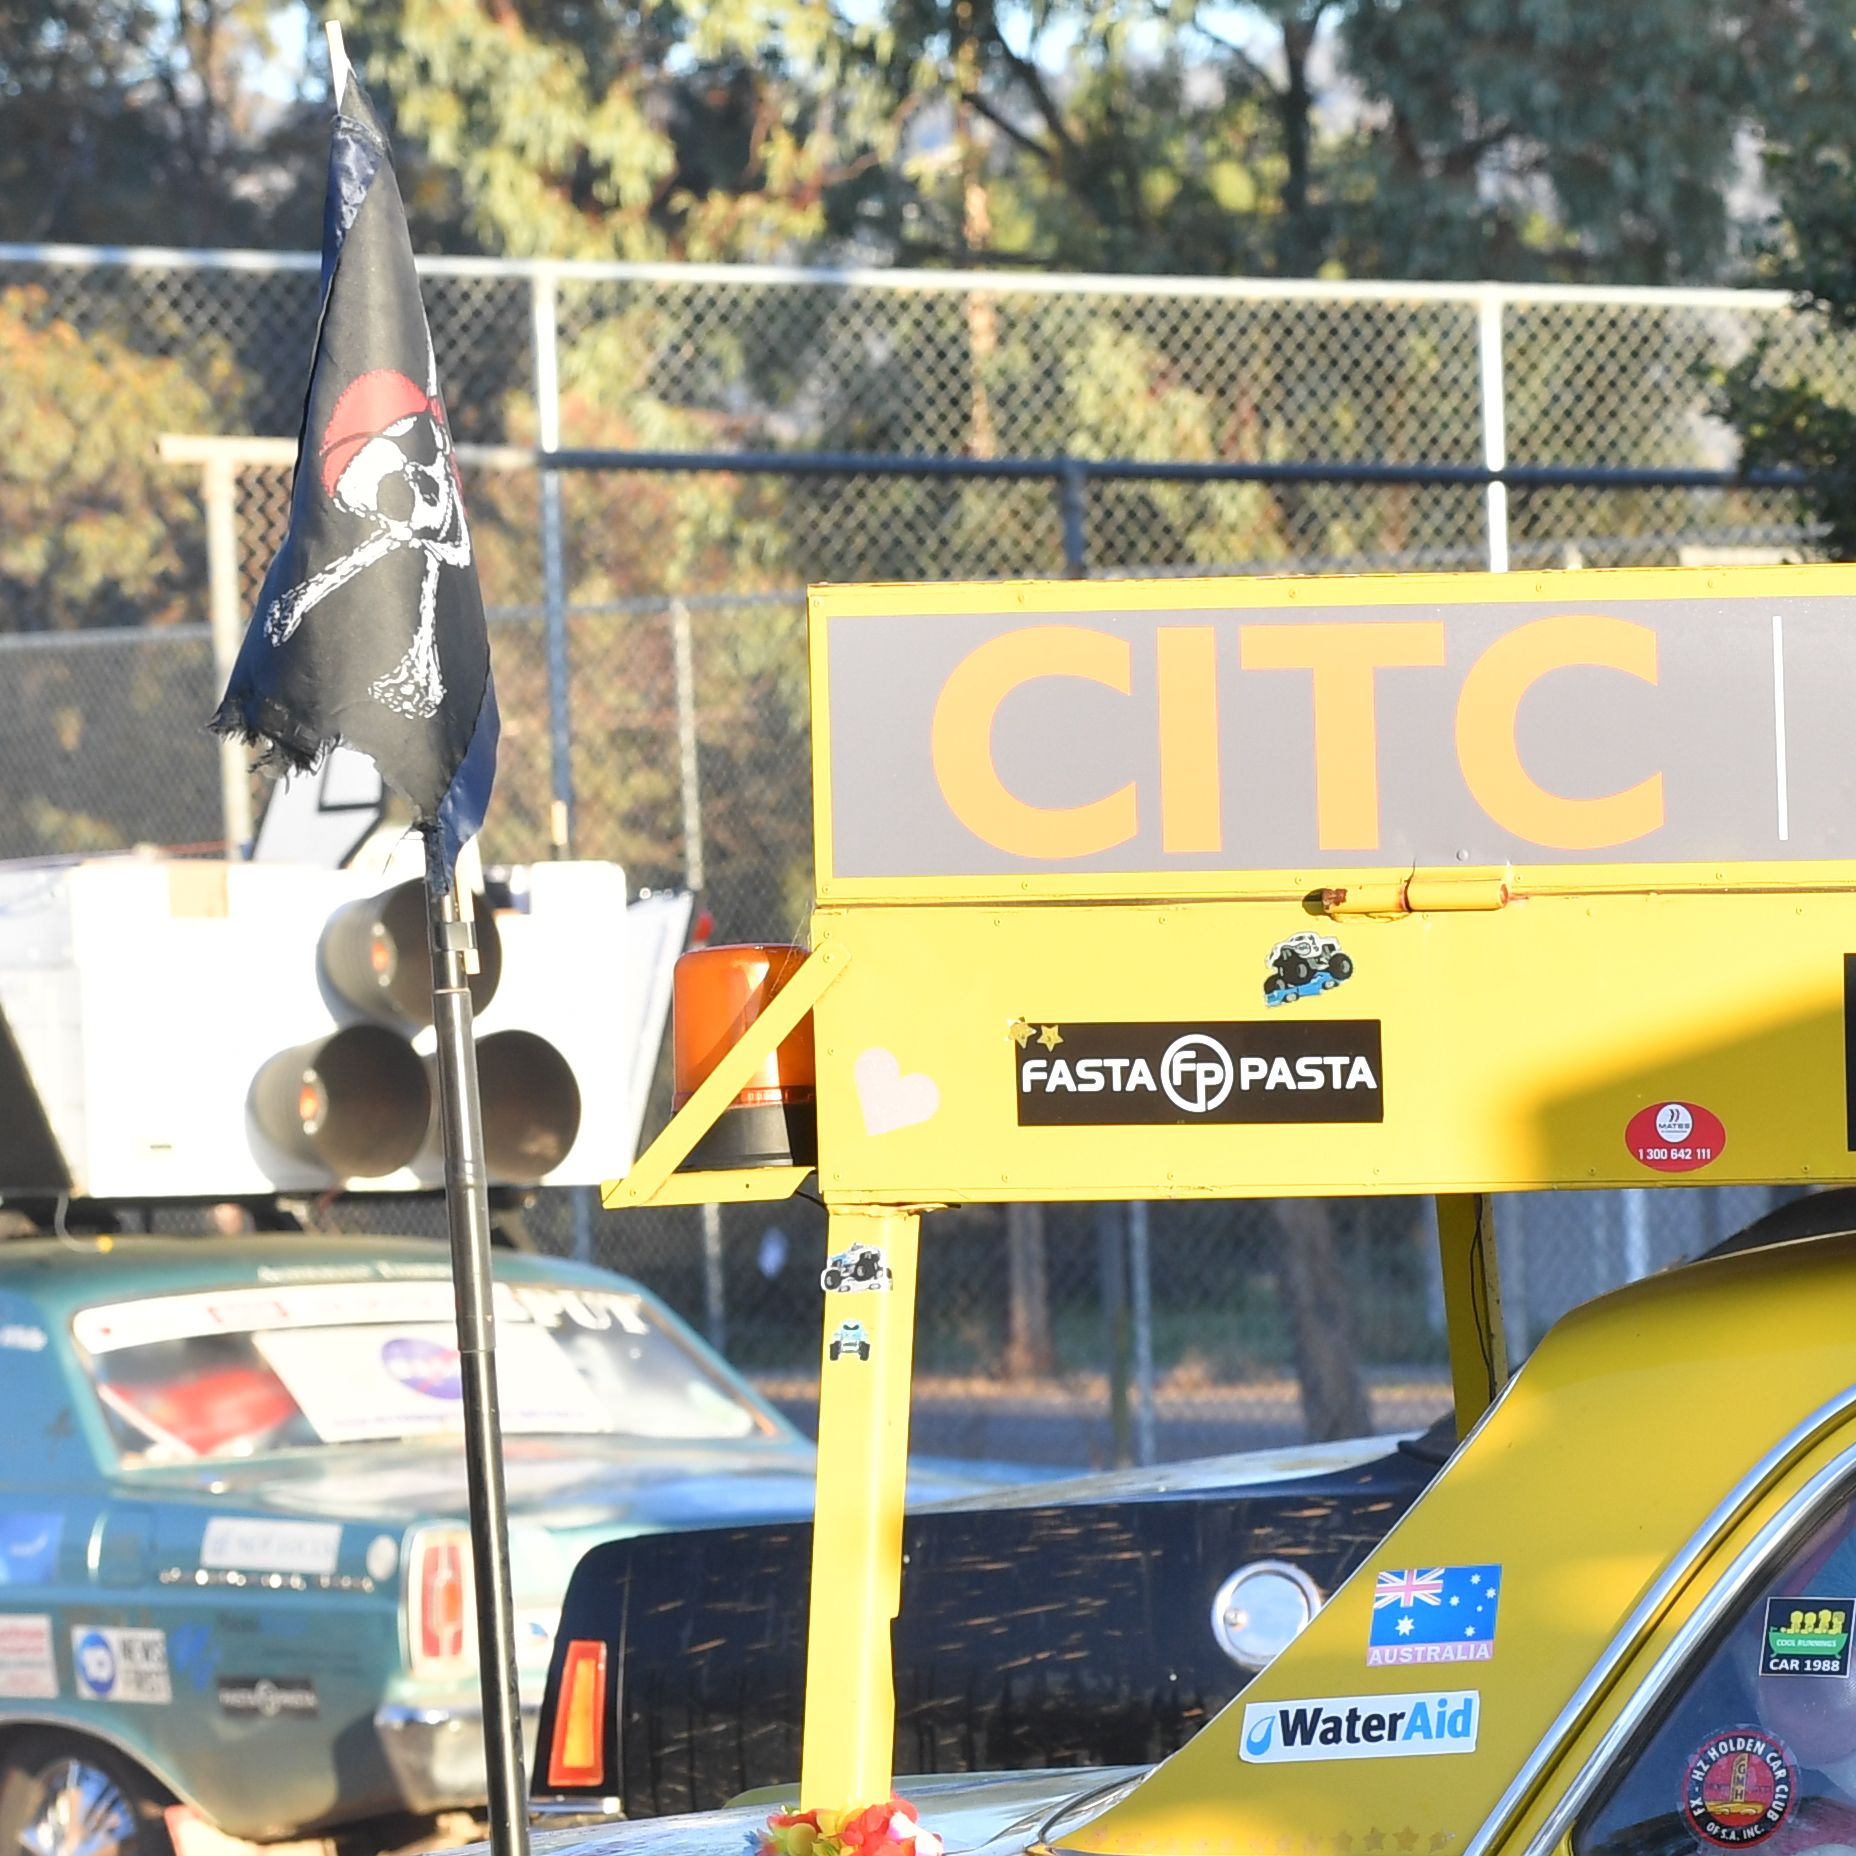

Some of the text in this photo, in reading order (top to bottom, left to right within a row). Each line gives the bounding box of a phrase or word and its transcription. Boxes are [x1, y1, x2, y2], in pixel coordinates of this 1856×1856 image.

[931, 612, 1666, 860] CITC
[1021, 1054, 1158, 1094] FASTA
[1239, 1053, 1377, 1092] PASTA
[1638, 1148, 1711, 1160] 1 300 642 111
[1368, 1641, 1492, 1665] AUSTRALIA
[1769, 1658, 1840, 1672] CAR 1988
[1279, 1697, 1473, 1748] WaterAid
[1706, 1737, 1766, 1762] HOLDEN
[1691, 1759, 1710, 1782] HZ
[1766, 1752, 1788, 1781] CAR
[1689, 1796, 1705, 1817] FX
[1766, 1784, 1789, 1822] CLUB
[1706, 1821, 1720, 1835] OF
